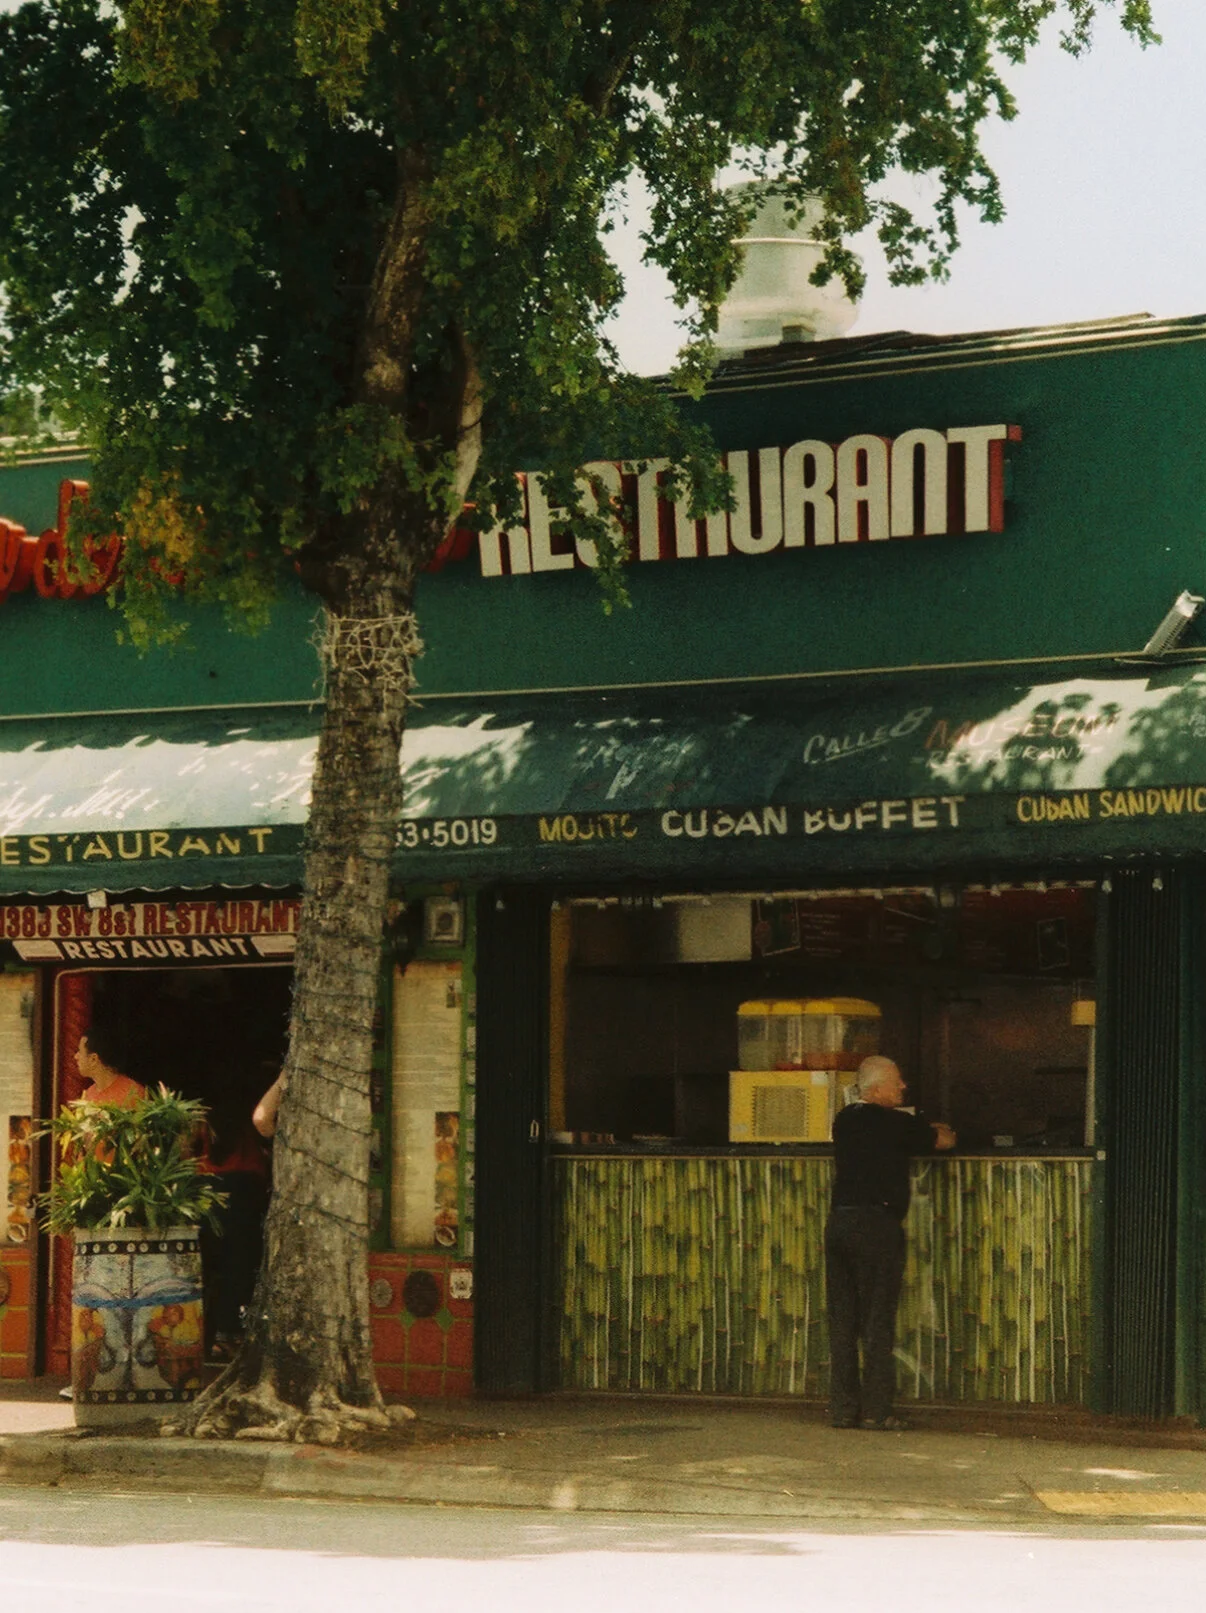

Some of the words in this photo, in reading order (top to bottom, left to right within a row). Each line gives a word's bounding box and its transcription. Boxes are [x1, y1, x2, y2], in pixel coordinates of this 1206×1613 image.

[803, 722, 893, 764] CALLE
[889, 706, 932, 737] 8
[661, 805, 788, 839] CUBAN
[804, 796, 966, 835] BUFFET
[1017, 793, 1091, 823] CUBAN
[56, 903, 93, 937] SW
[143, 900, 301, 937] RESTAURANT
[61, 938, 249, 960] RESTAURANT
